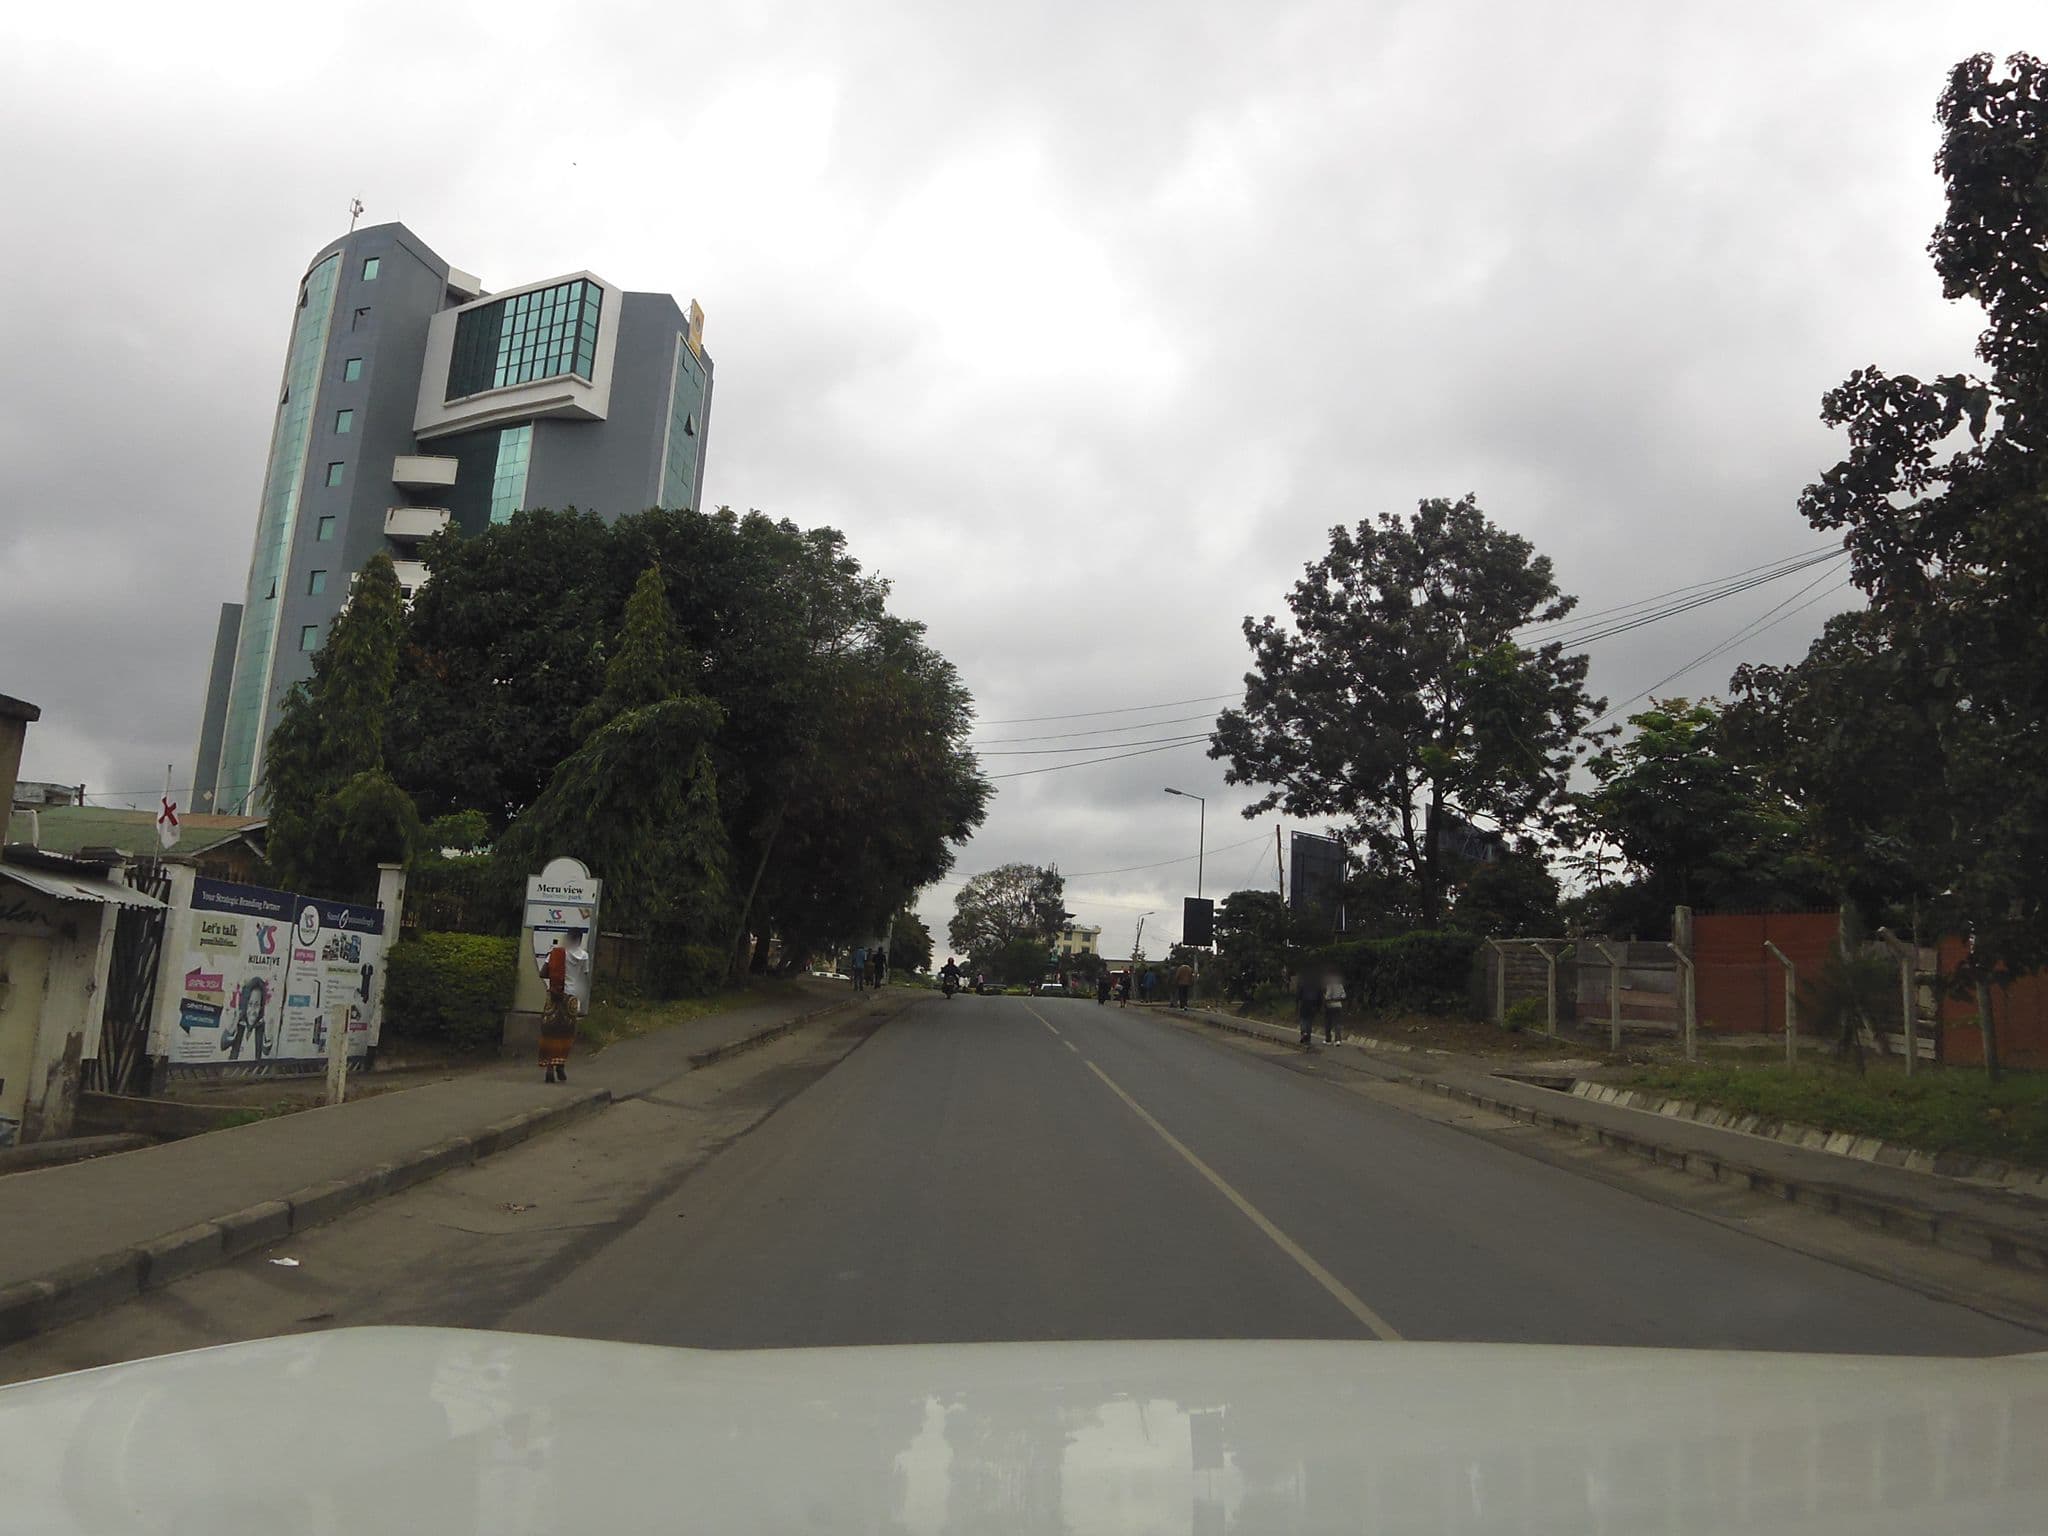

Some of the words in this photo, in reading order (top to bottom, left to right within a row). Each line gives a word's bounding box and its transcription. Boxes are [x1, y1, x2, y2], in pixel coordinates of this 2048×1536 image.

[537, 884, 561, 893] Meru
[564, 885, 583, 894] view
[202, 890, 216, 901] Your
[215, 892, 239, 906] Strategic
[239, 896, 263, 910] Branding
[263, 900, 281, 912] Partner
[202, 921, 221, 934] Let's
[222, 924, 237, 936] talk
